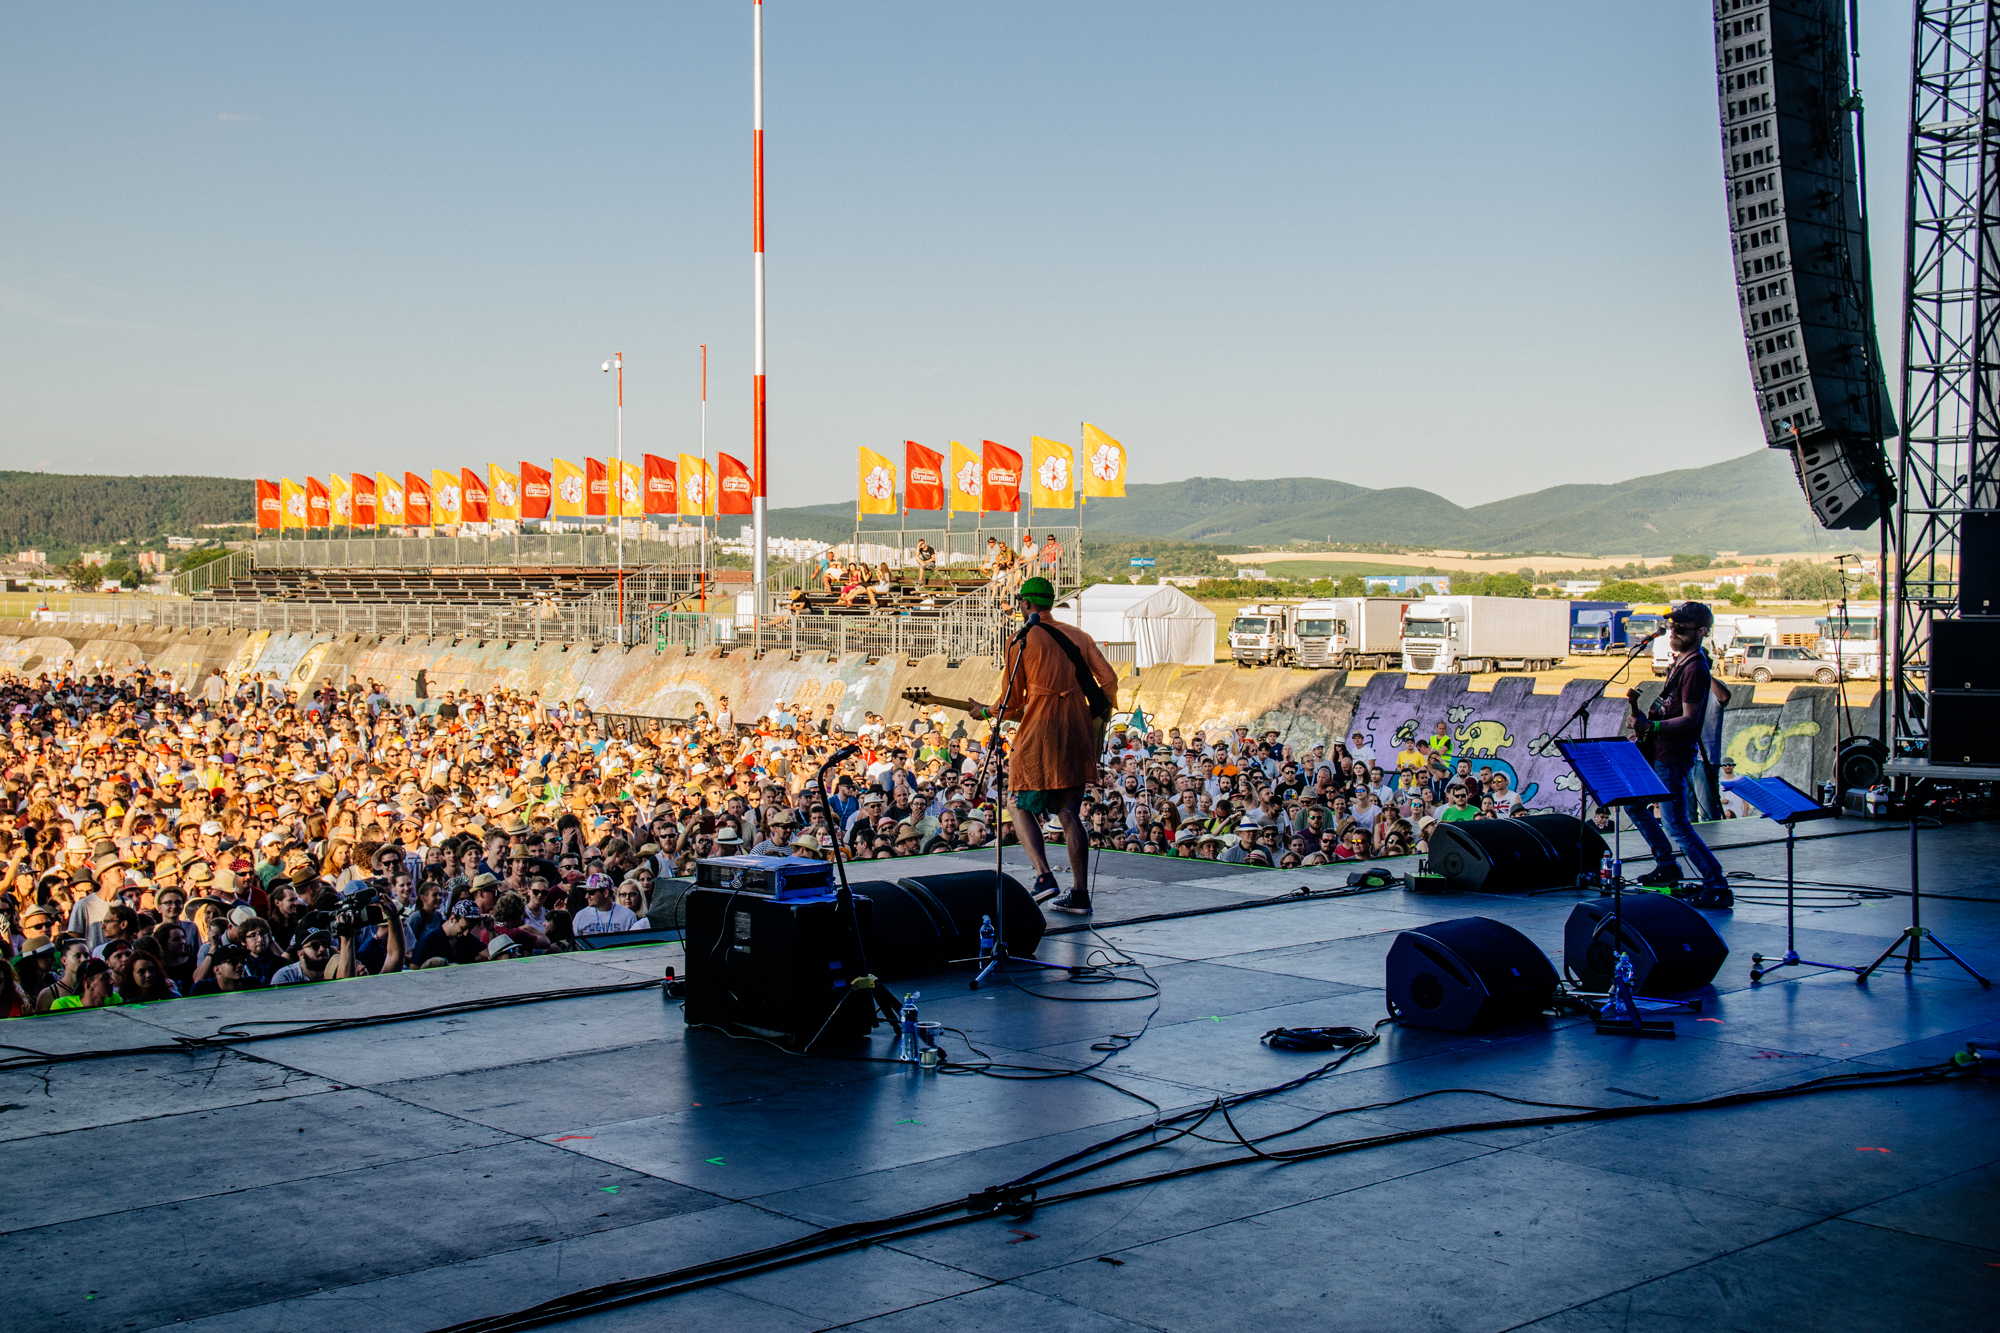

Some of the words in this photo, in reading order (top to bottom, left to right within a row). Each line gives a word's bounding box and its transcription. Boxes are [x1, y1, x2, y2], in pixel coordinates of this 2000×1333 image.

[913, 471, 936, 483] Urpiner
[991, 473, 1014, 482] Urpiner
[651, 482, 671, 490] Urpiner
[725, 481, 747, 490] Urpiner
